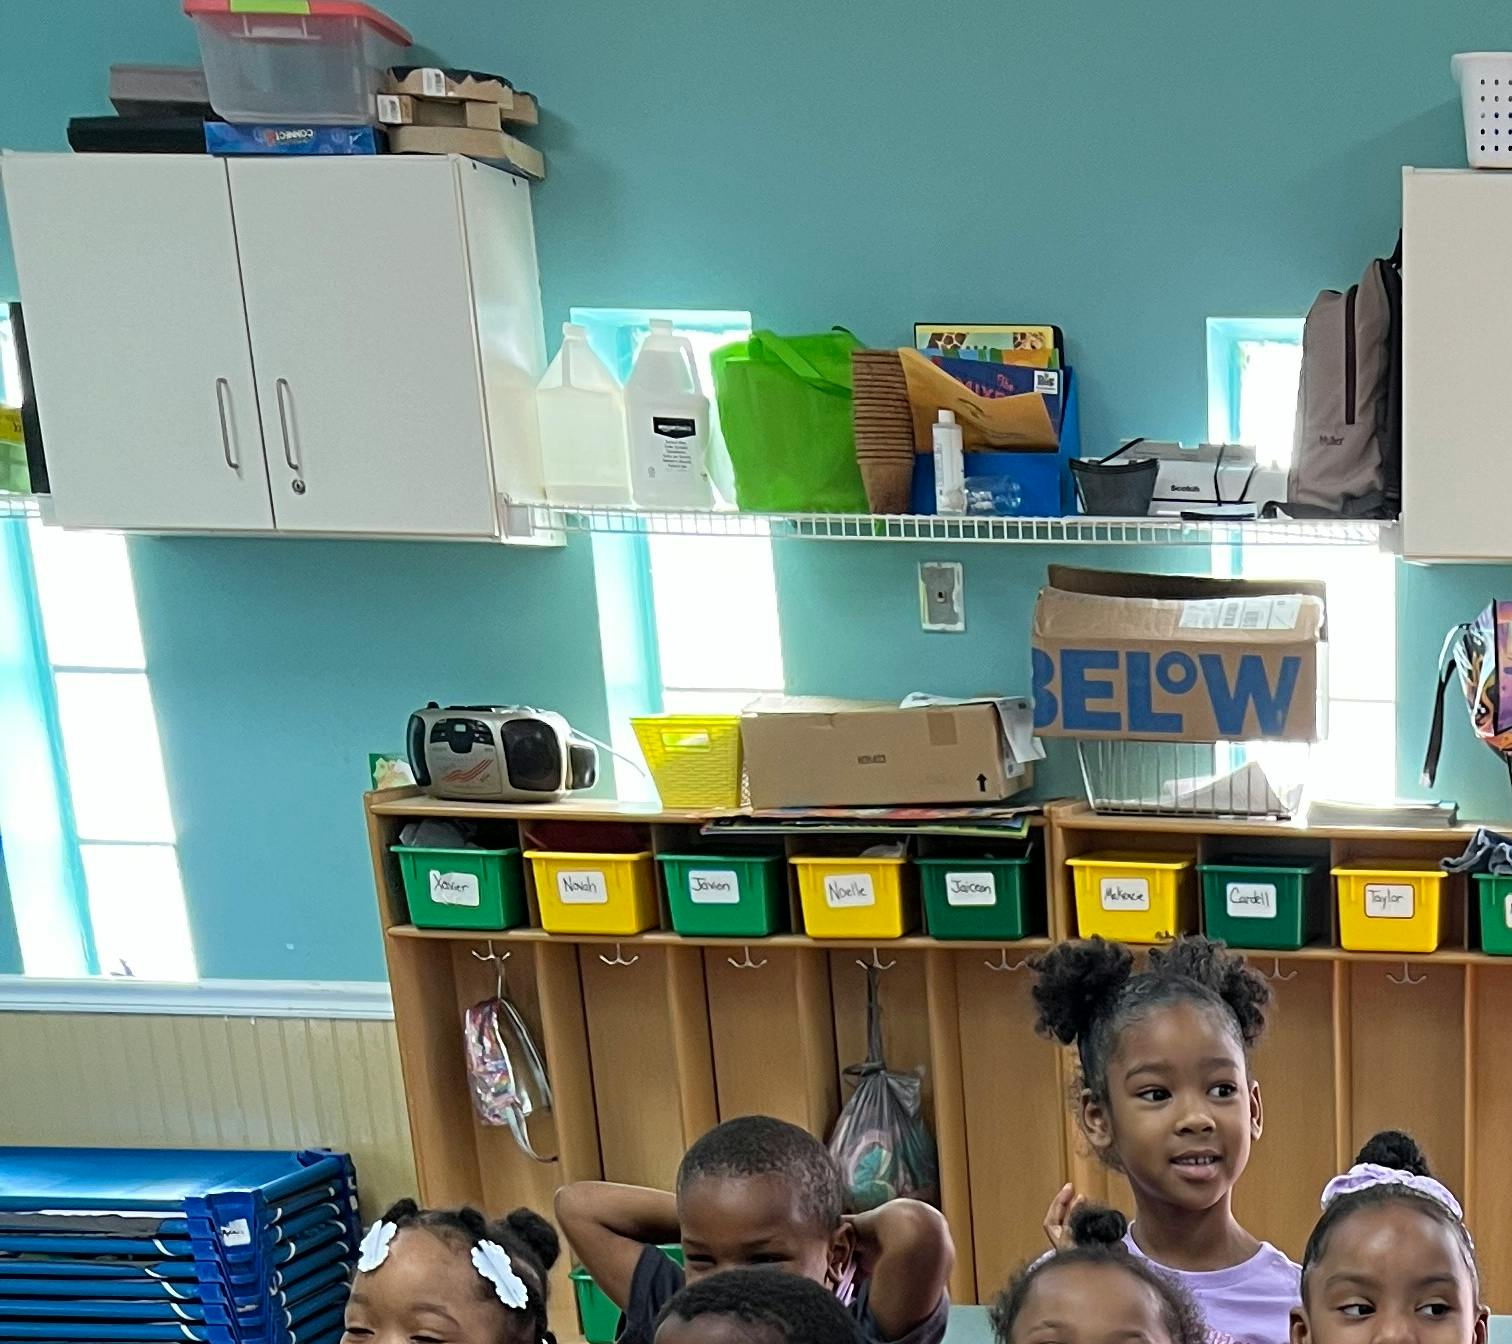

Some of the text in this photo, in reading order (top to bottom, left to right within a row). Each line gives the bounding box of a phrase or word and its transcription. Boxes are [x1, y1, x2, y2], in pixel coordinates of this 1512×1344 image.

[1031, 647, 1302, 736] BELOW
[828, 882, 868, 901] Noelle
[1368, 887, 1404, 911] Taylor
